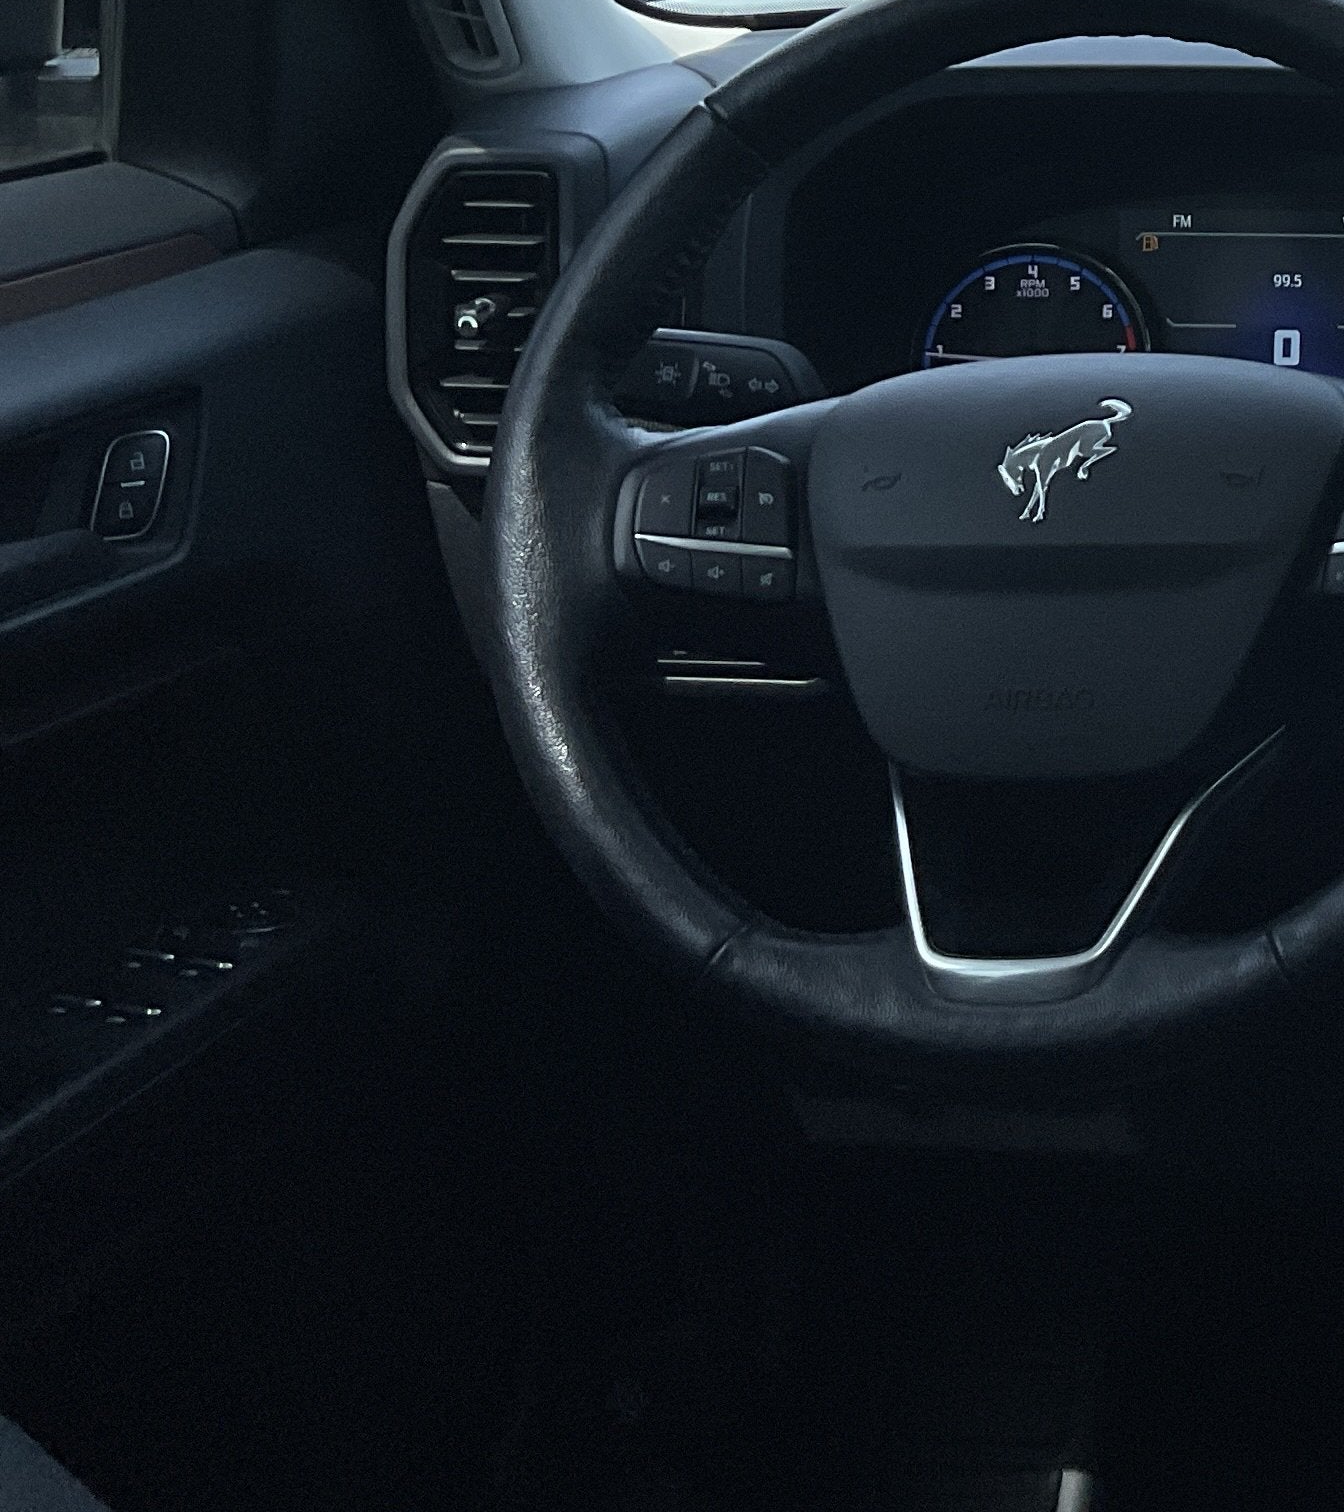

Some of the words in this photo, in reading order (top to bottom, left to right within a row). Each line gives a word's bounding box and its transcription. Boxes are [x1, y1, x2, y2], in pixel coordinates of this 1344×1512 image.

[1173, 214, 1192, 229] FM
[1028, 264, 1039, 279] 4
[984, 276, 995, 291] 3
[1020, 279, 1046, 289] RPM
[1070, 276, 1081, 291] 5
[1273, 273, 1303, 288] 99.5
[1016, 288, 1050, 298] x1000
[950, 303, 962, 318] 2
[1102, 304, 1113, 319] 6
[1273, 329, 1301, 366] 0
